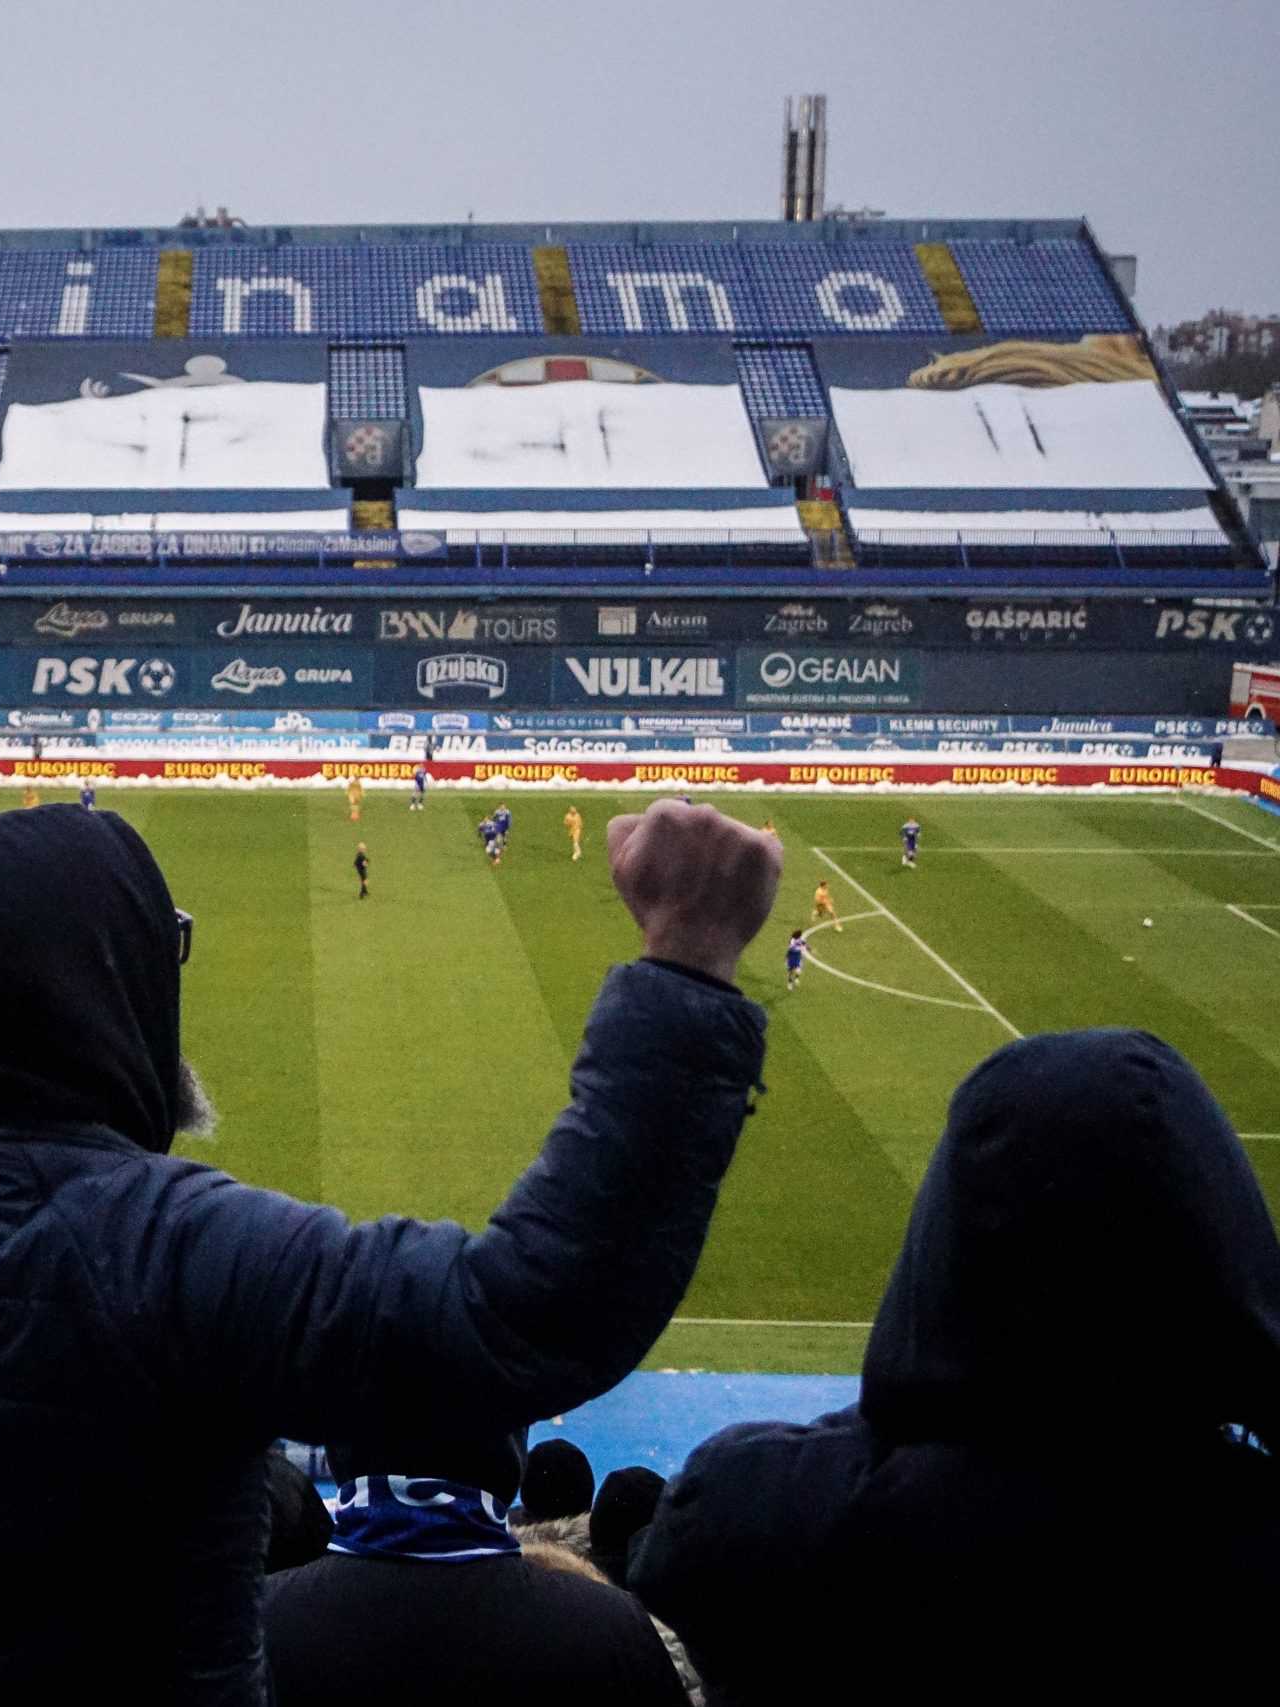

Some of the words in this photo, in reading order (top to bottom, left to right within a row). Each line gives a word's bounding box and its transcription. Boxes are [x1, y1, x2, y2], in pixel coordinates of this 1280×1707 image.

[63, 534, 83, 555] ZA
[217, 604, 352, 637] Jamnica
[645, 610, 708, 629] Agram
[764, 609, 829, 637] Zagreb
[849, 609, 913, 637] Zagreb
[1156, 609, 1240, 641] PSK
[480, 618, 557, 641] TOURS
[32, 657, 137, 694] PSK
[294, 668, 353, 683] GRUPA
[797, 657, 901, 683] GEALAN
[889, 719, 934, 731] KLEMM
[937, 719, 998, 731] SECURITY
[1154, 720, 1189, 734] PSK
[1215, 720, 1250, 735] PSK
[523, 736, 628, 754] SofaScore
[1081, 743, 1120, 757] PSK
[1147, 743, 1187, 758] PSK
[14, 761, 117, 777] EUROHERC
[164, 762, 266, 777] EUROHERC
[474, 764, 578, 780] EUROHERC
[635, 765, 739, 781] EUROHERC
[789, 766, 894, 781] EUROHERC
[952, 767, 1057, 782] EUROHERC
[1109, 767, 1217, 785] EUROHERC
